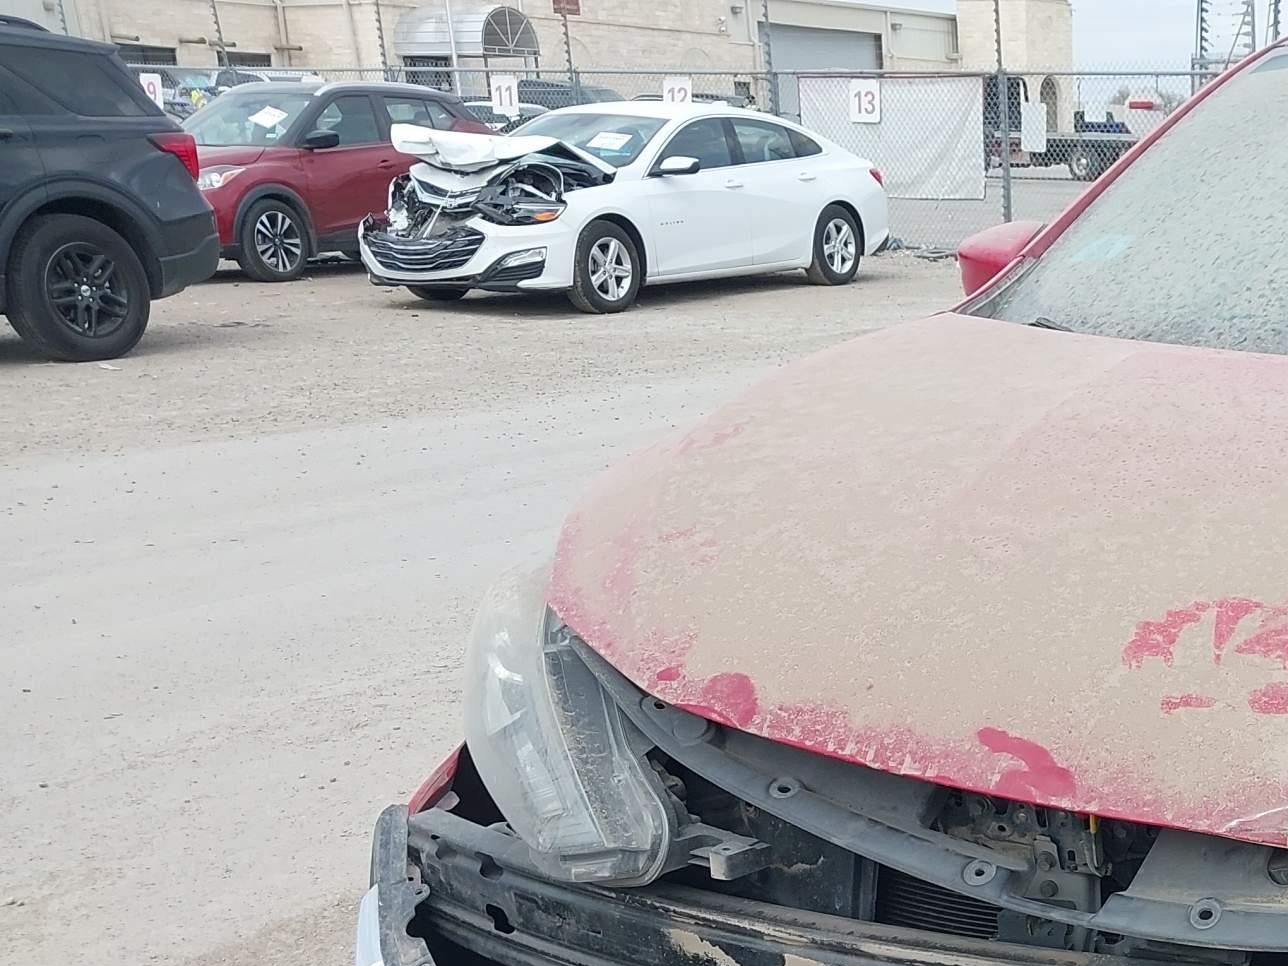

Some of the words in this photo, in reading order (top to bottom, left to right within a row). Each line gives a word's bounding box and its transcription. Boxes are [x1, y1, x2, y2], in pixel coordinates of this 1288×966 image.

[495, 85, 513, 106] 11
[667, 87, 688, 102] 12
[854, 91, 876, 114] 13
